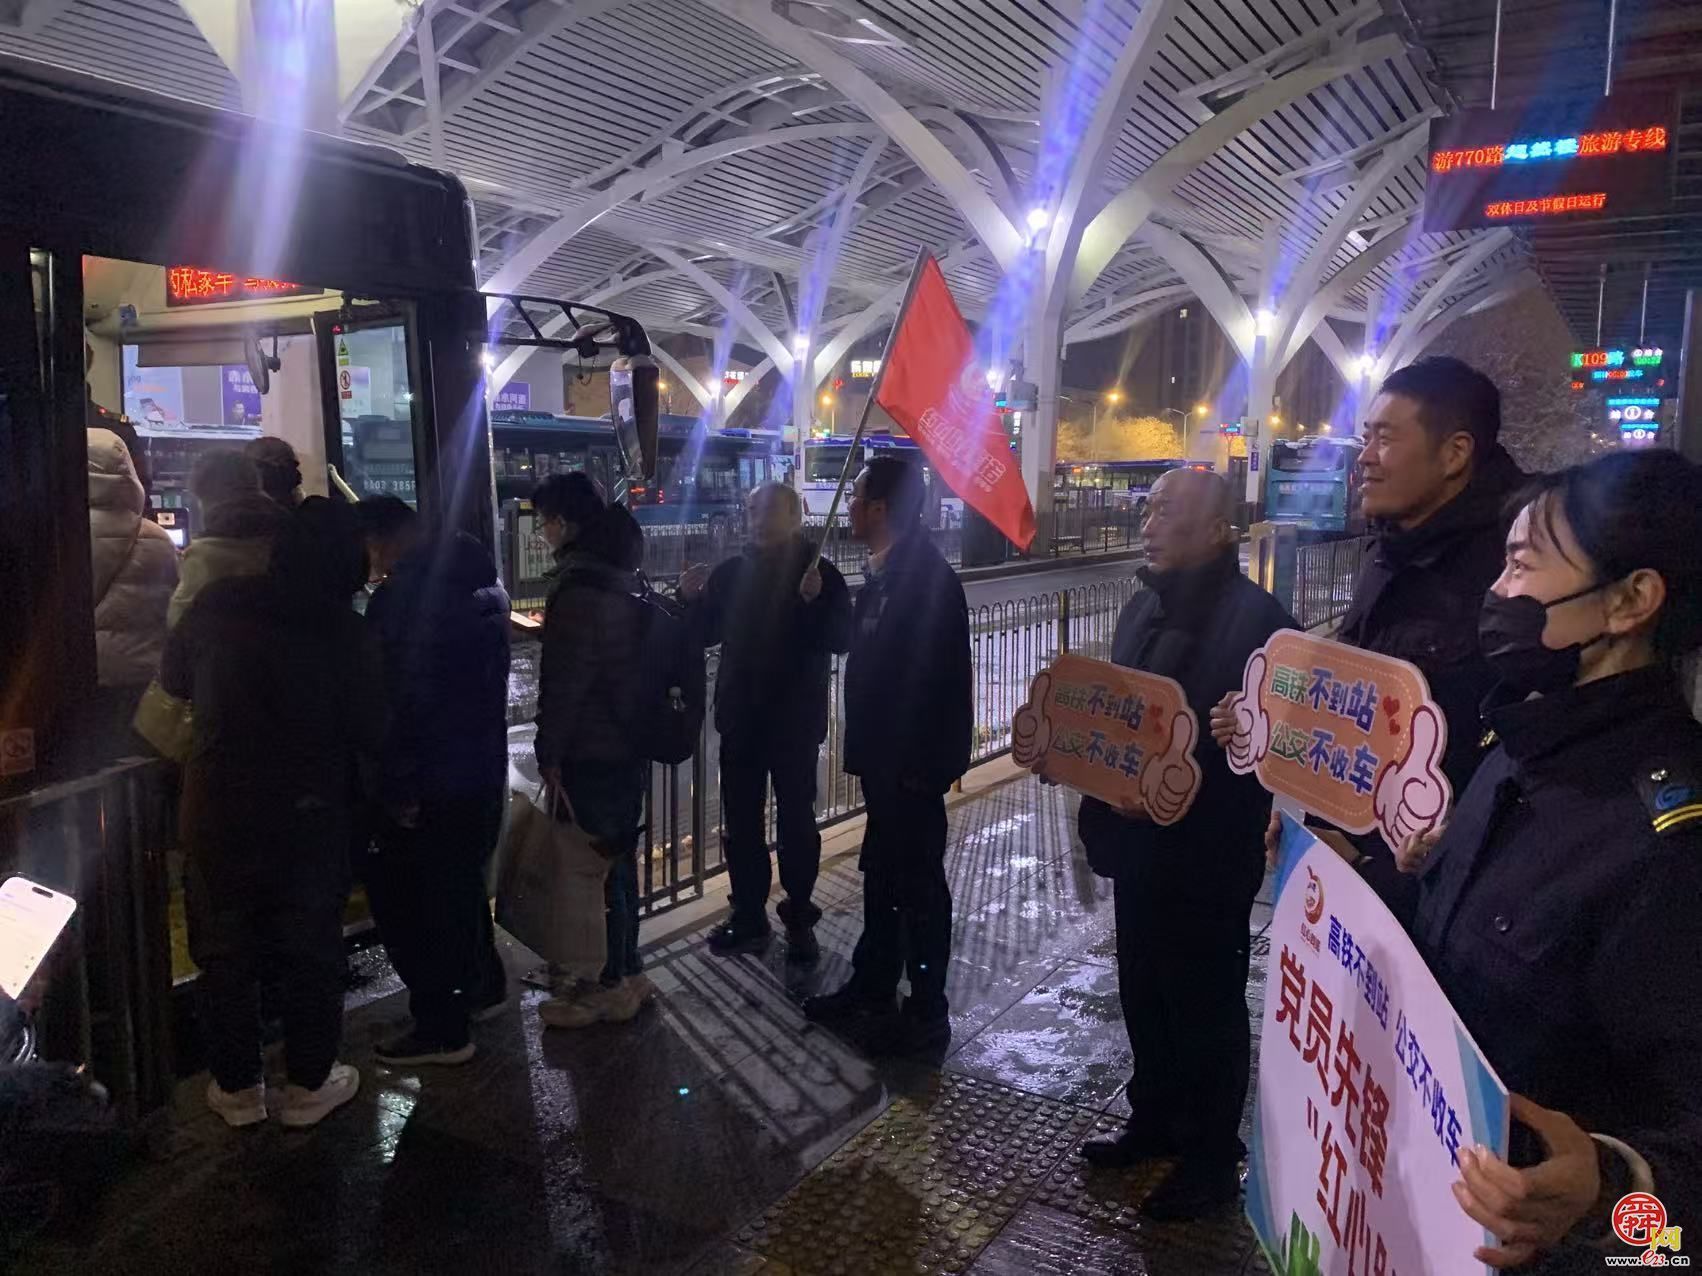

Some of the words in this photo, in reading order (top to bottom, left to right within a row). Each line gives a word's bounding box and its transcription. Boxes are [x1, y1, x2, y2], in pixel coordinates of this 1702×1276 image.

[1486, 193, 1607, 217] 双休日及节假日运行
[1055, 683, 1145, 731] 高铁不到站
[1270, 665, 1377, 734] 高铁不到站
[1053, 727, 1144, 778] 公交不收车
[1269, 719, 1379, 795] 公交不收车
[1275, 944, 1390, 1200] 党员先锋
[1328, 914, 1391, 1031] 高铁不到站
[1395, 1009, 1463, 1168] 公交不收车
